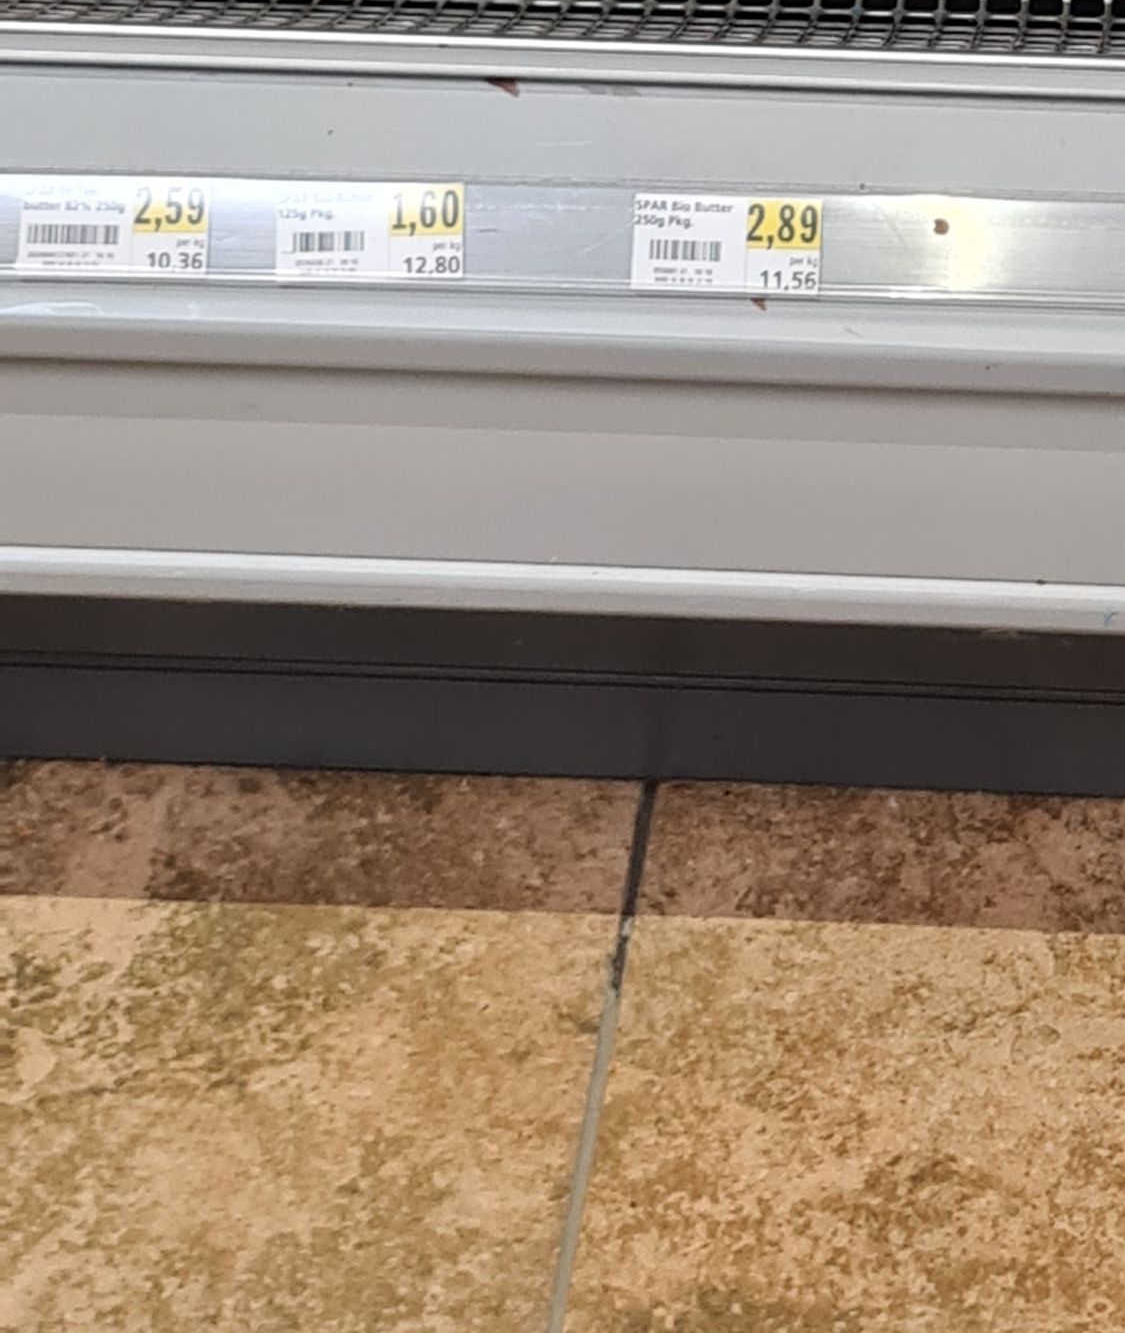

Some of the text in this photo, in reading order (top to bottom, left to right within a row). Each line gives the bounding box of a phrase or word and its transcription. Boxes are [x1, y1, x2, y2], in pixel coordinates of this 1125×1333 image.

[134, 189, 205, 231] 2,59
[391, 190, 460, 232] 1,60
[635, 200, 734, 214] SPAR Bio Butter
[747, 205, 818, 249] 2,89
[146, 252, 203, 271] 10,36
[403, 256, 461, 275] 12,80
[760, 271, 817, 291] 11,56
